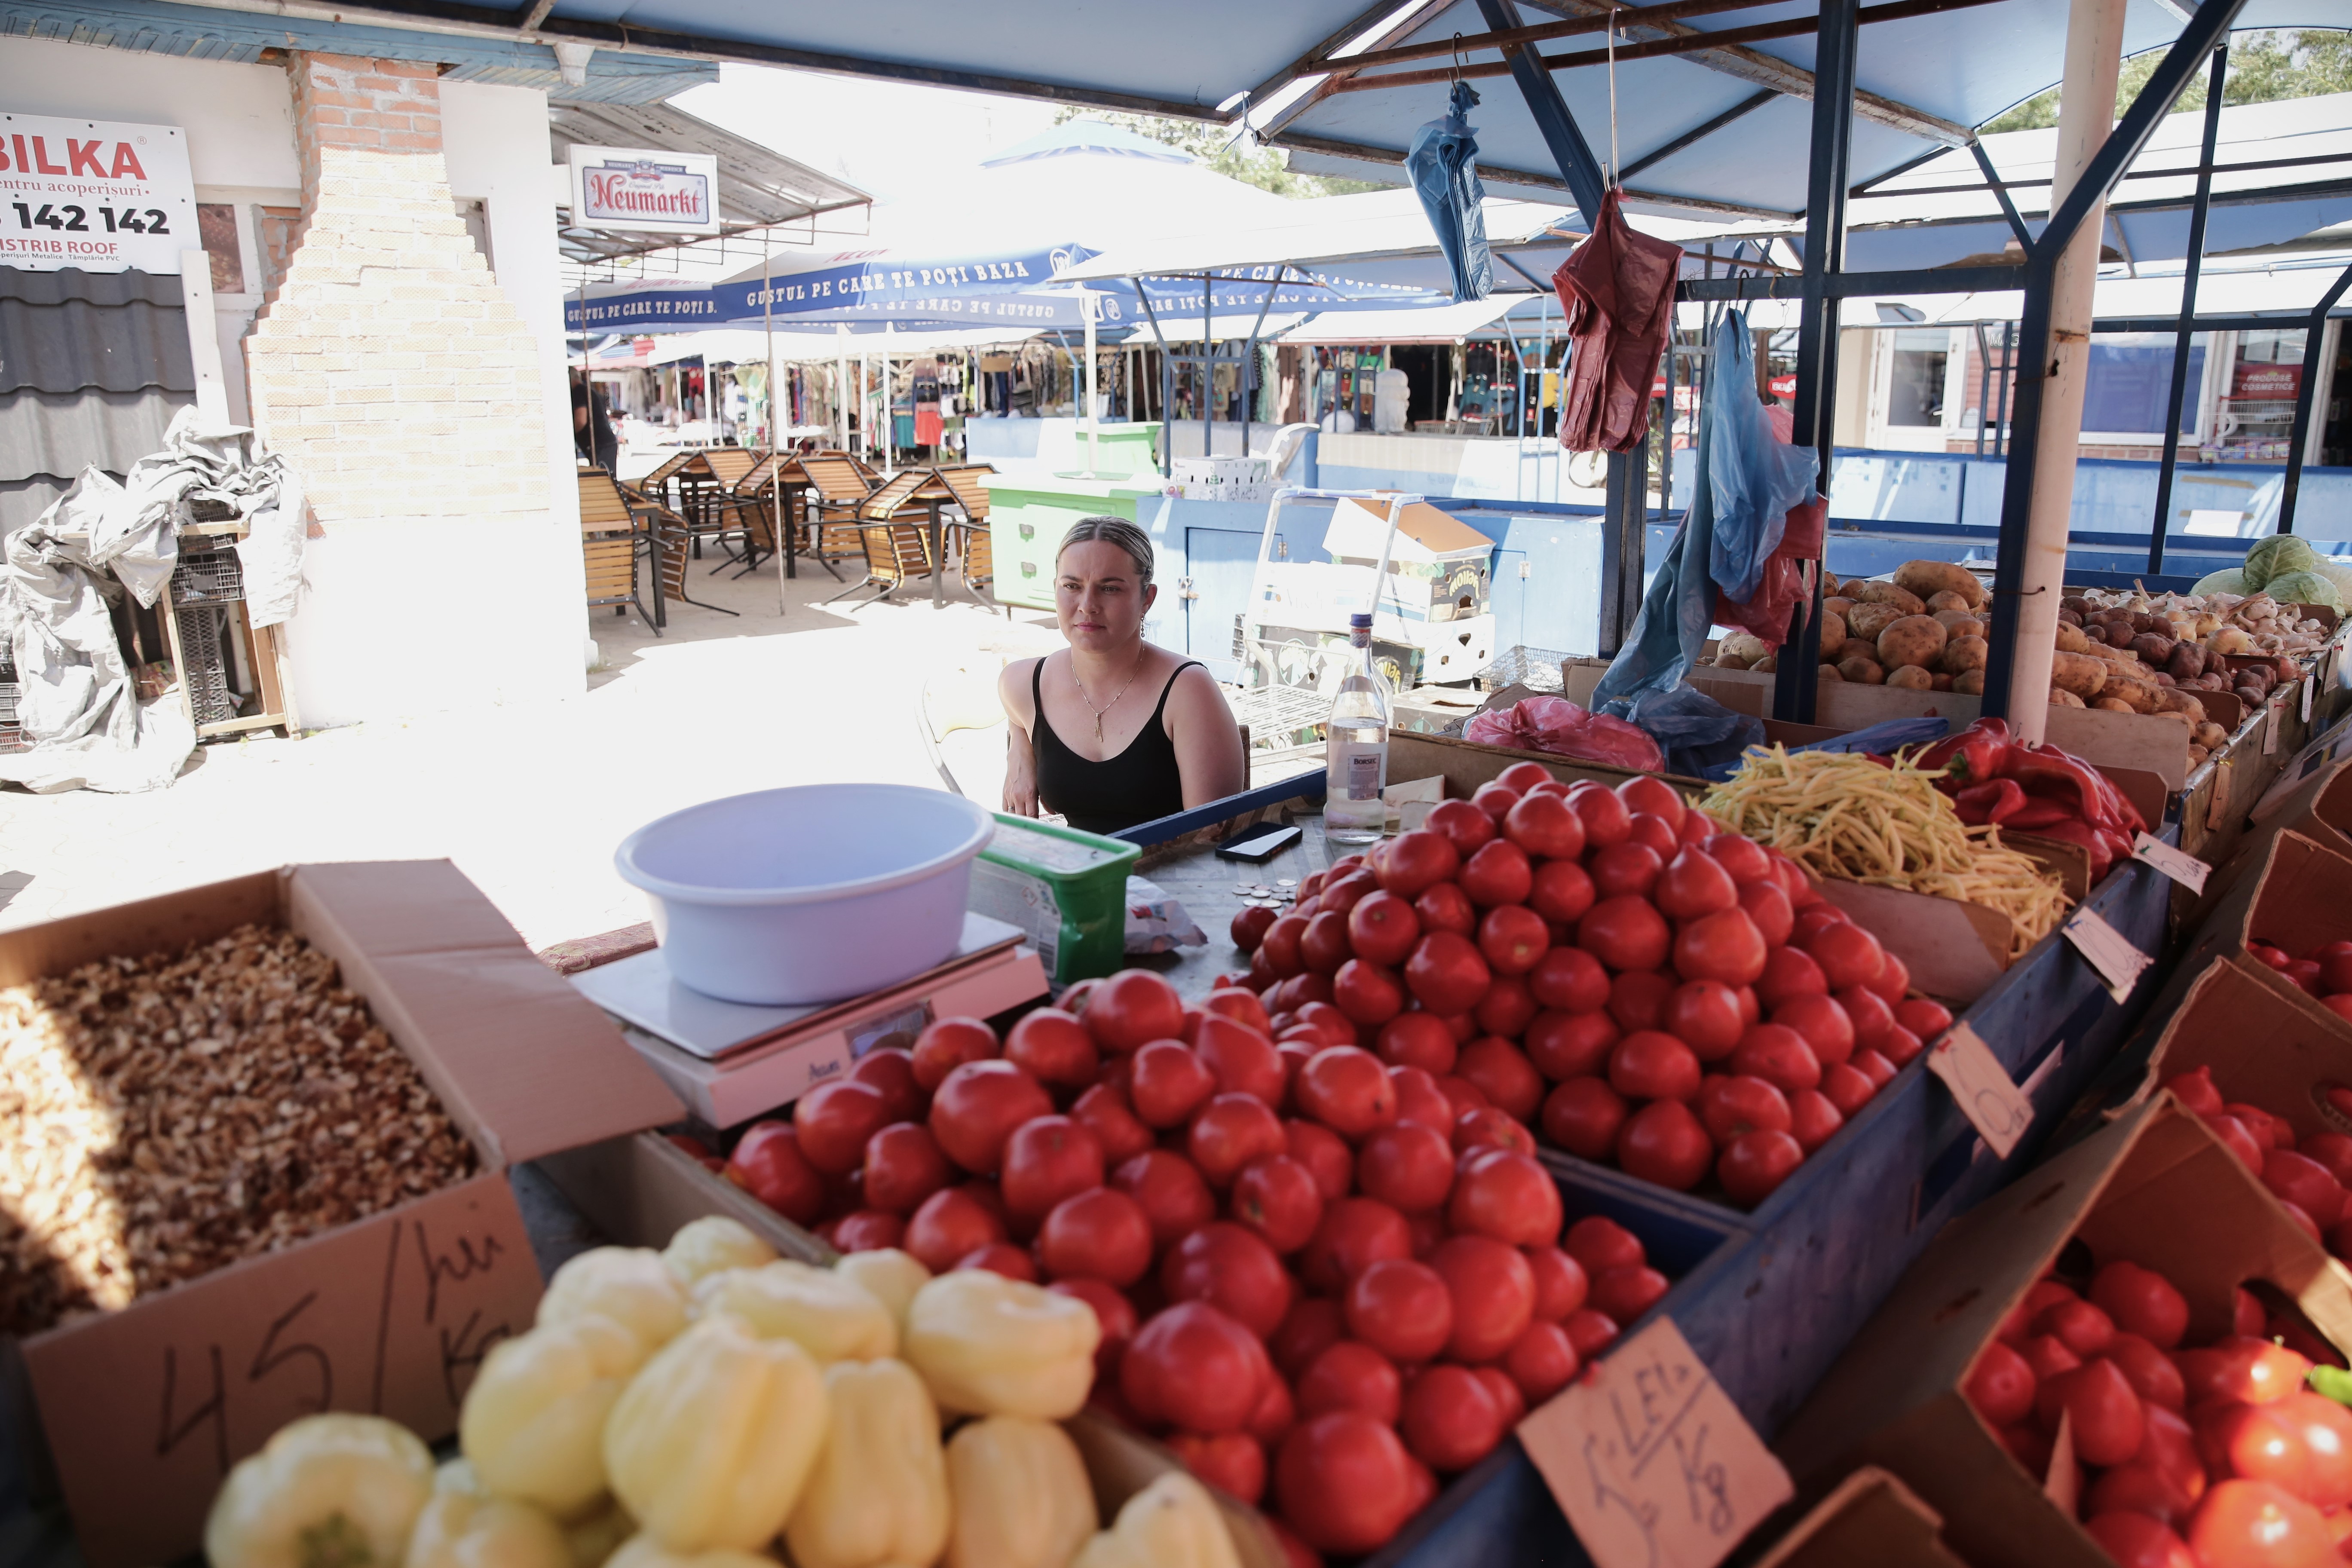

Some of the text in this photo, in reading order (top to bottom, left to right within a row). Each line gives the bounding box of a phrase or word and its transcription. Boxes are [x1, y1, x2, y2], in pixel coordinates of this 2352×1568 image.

[590, 174, 701, 214] Neumarkt
[12, 202, 170, 235] 142 142
[67, 241, 118, 255] ROOF
[747, 285, 805, 307] GUSTUL
[812, 280, 831, 298] PE
[838, 273, 885, 294] CARE
[891, 271, 915, 288] TE
[920, 266, 969, 288] POȚI
[974, 261, 1029, 281] BAZA
[567, 308, 604, 322] GUTUL
[607, 304, 620, 318] PE
[623, 301, 652, 316] CARE
[655, 301, 670, 314] TE
[2242, 382, 2295, 391] COSMETICE
[2246, 373, 2293, 383] PRODUSE
